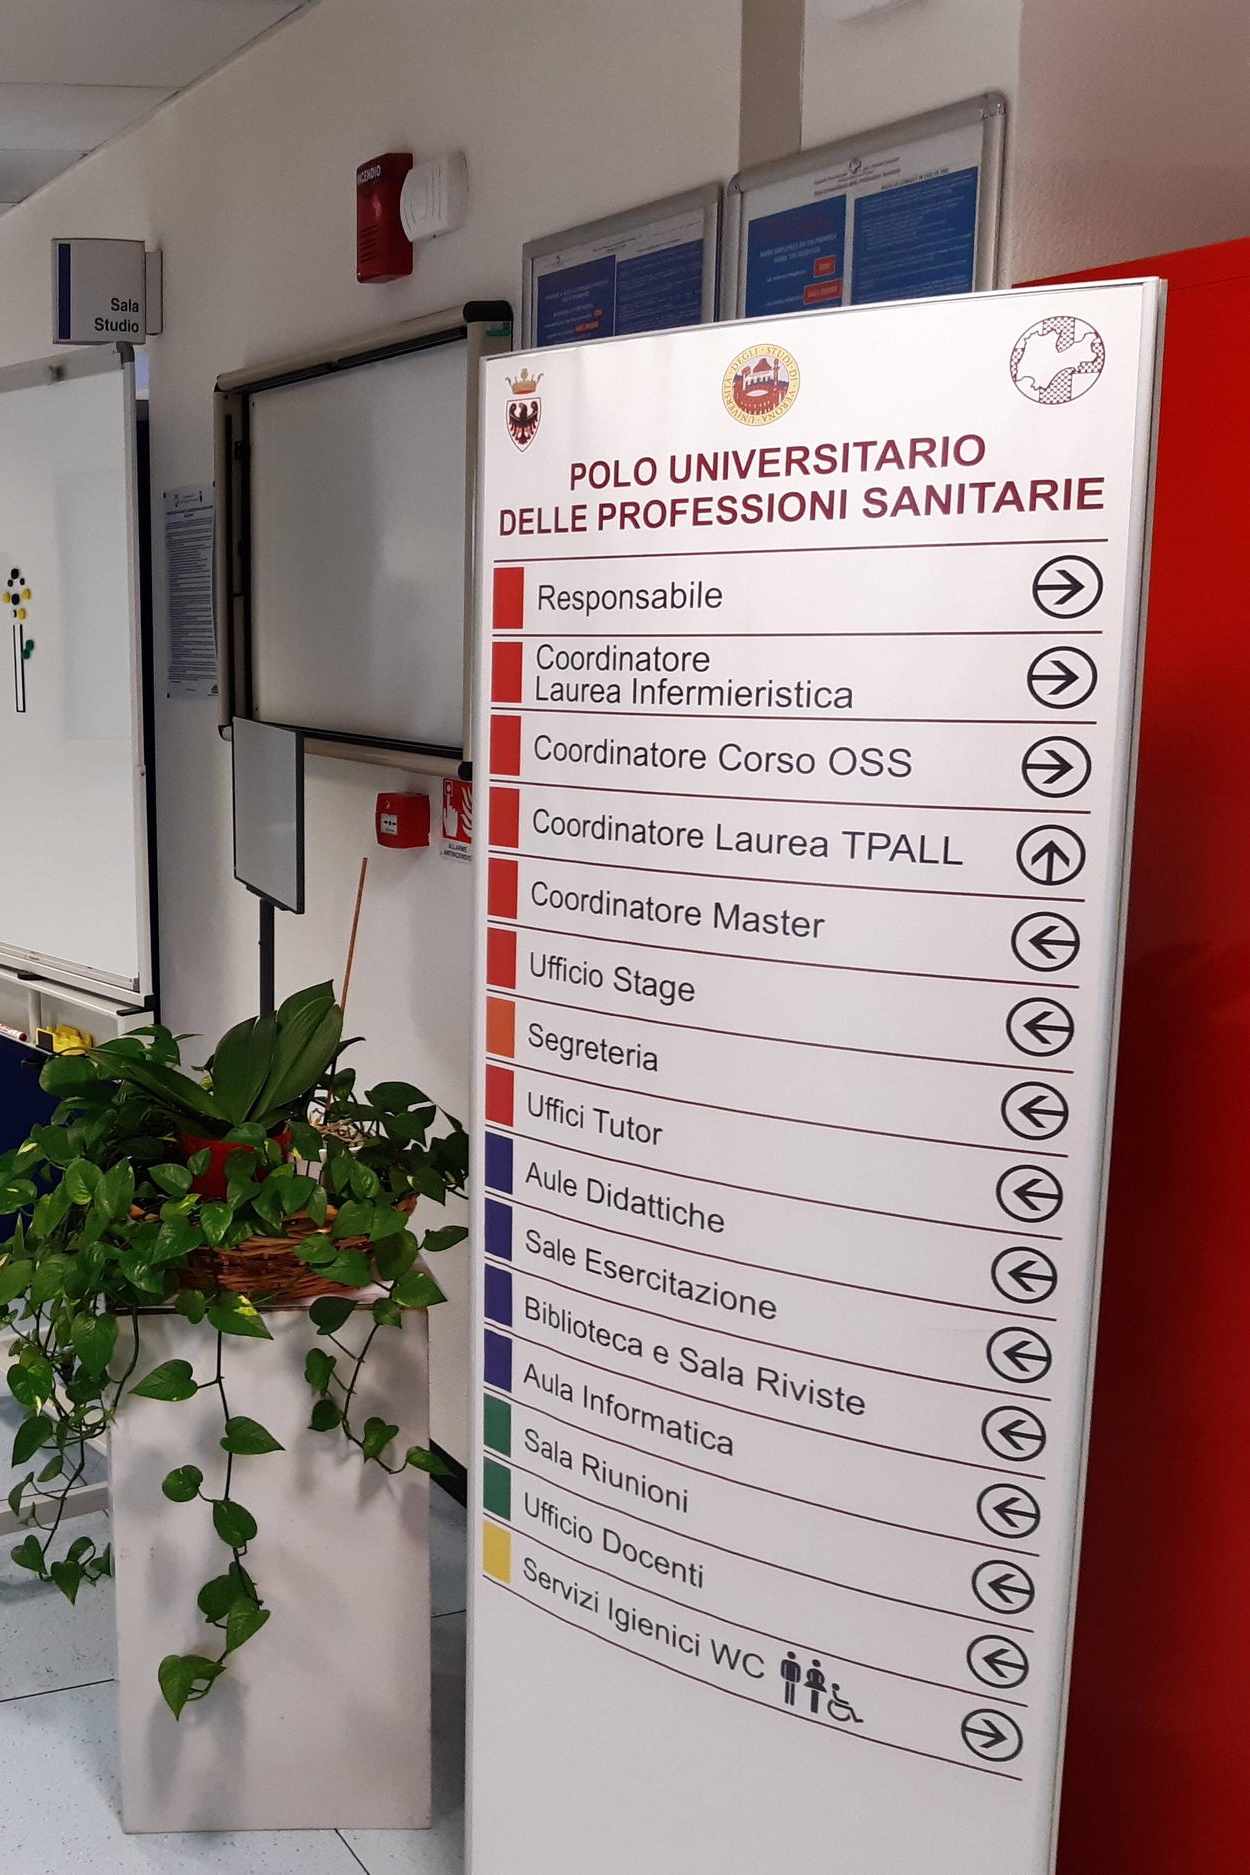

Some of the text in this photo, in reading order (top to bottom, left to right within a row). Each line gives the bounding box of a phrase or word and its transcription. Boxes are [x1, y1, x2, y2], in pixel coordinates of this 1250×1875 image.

[94, 317, 139, 333] Studio
[111, 298, 139, 313] Sala
[731, 348, 758, 371] DEGLI
[766, 346, 793, 367] STUDI
[789, 369, 798, 381] DI
[761, 391, 795, 422] VERONA
[569, 433, 986, 492] POLO UNIVERSITARIO
[498, 476, 1105, 537] DELLE PROFESSIONI SANITARIE
[537, 580, 723, 618] Responsabile
[535, 643, 711, 673] Coordinatore
[534, 675, 853, 709] Laurea Infermieristica
[533, 734, 912, 778] Coordinatore Corso OSS
[531, 808, 964, 866] Coordinatore Laurea TPALL
[530, 880, 826, 939] Coordinatore Master
[529, 951, 696, 1007] Ufficio Stage
[527, 1022, 659, 1072] Segreteria
[526, 1091, 664, 1146] Uffici Tutor
[524, 1161, 725, 1234] Aule Didattiche
[524, 1229, 778, 1320] Sale Esercitazione
[524, 1295, 866, 1416] Biblioteca e Sala Riviste
[522, 1363, 734, 1457] Aula Informatica
[523, 1428, 688, 1514] Sala Riunioni
[523, 1491, 703, 1589] Ufficio Docenti
[522, 1557, 765, 1679] Servizi Igienici WC
